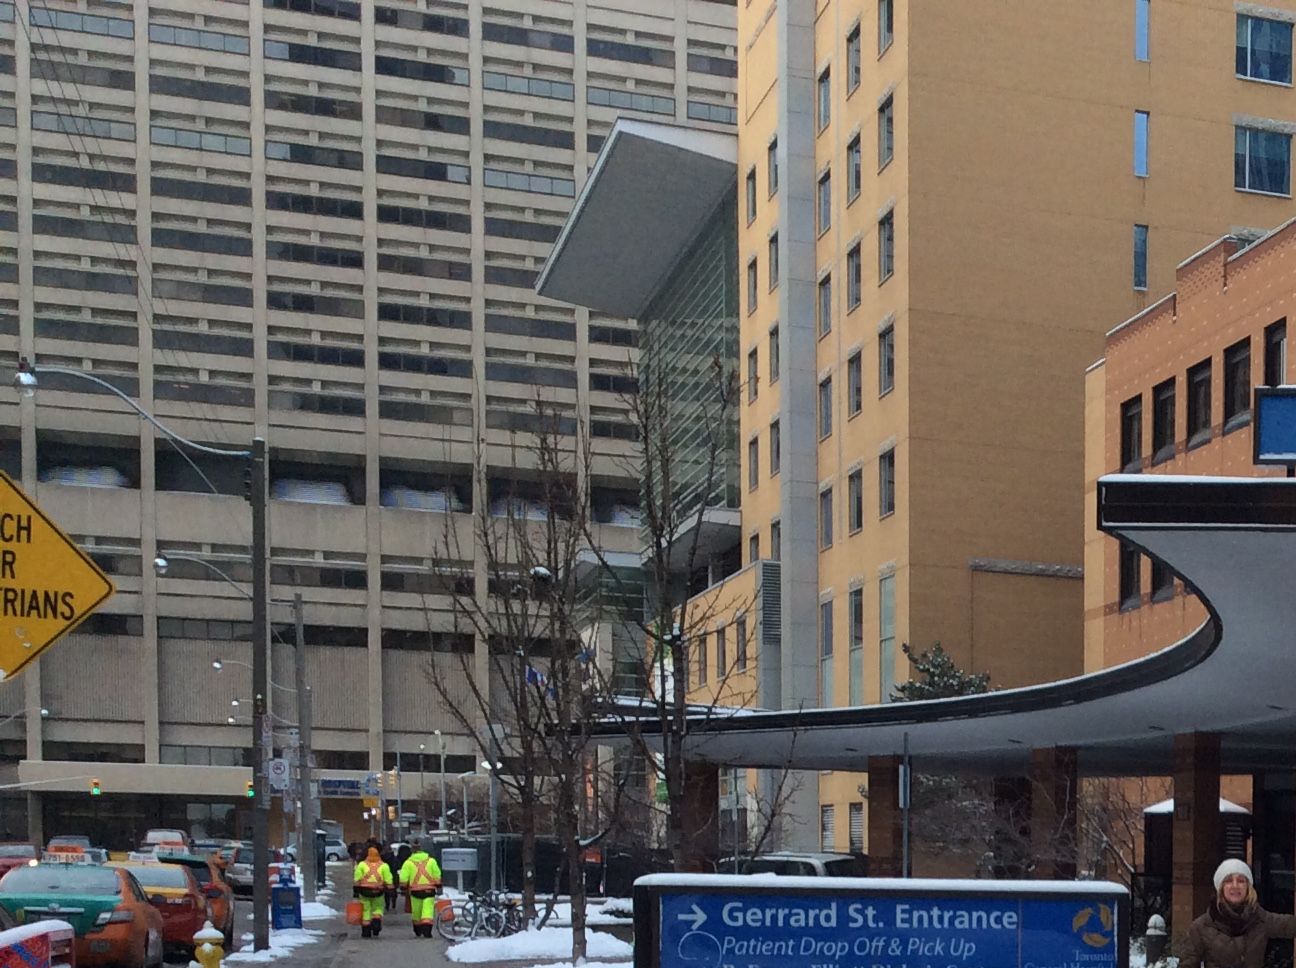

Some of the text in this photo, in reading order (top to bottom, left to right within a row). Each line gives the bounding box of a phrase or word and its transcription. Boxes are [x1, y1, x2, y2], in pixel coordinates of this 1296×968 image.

[0, 587, 75, 621] RIANS
[721, 902, 1018, 929] Gerrard St. Entrance
[722, 936, 976, 960] Patient Drop Off & Pick Up
[1073, 949, 1114, 962] Toronto
